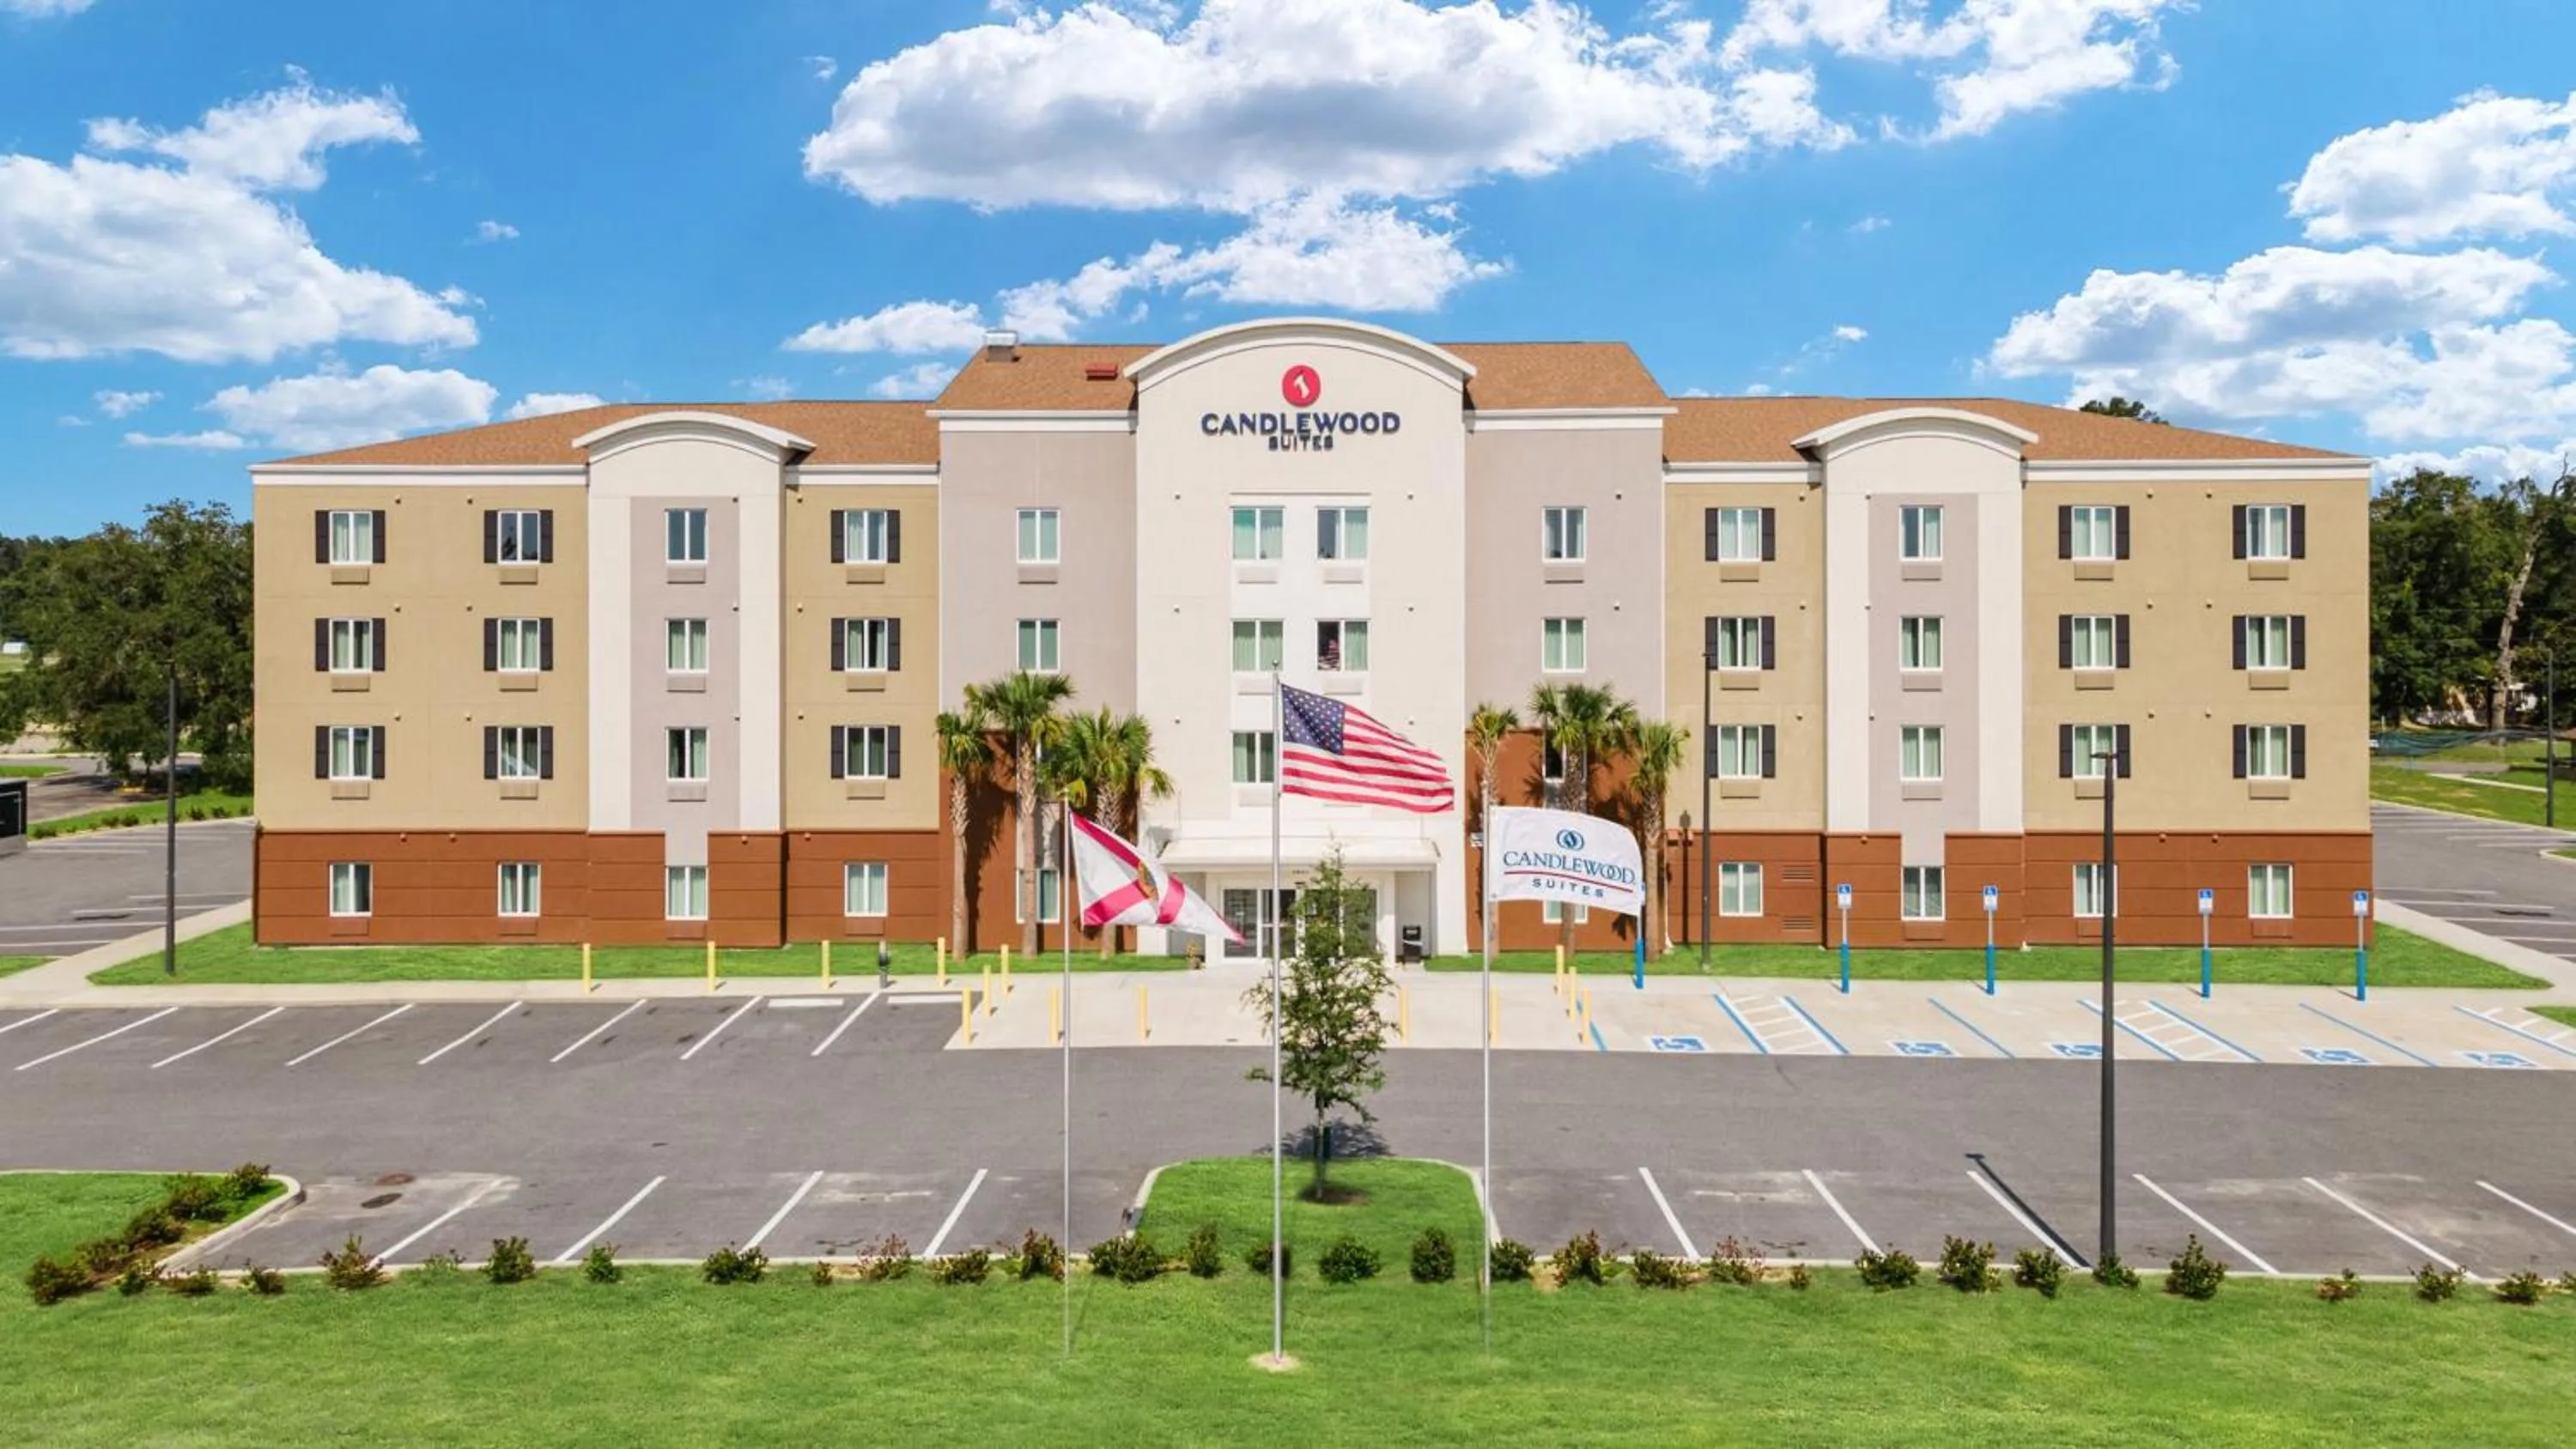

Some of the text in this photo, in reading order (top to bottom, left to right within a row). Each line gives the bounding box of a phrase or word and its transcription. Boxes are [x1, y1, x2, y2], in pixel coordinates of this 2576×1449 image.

[1200, 412, 1400, 434] CANDLEWOOD
[1269, 435, 1334, 451] SUITES
[1504, 851, 1636, 883] CANDLEWOOD
[1533, 878, 1604, 897] SUITES
